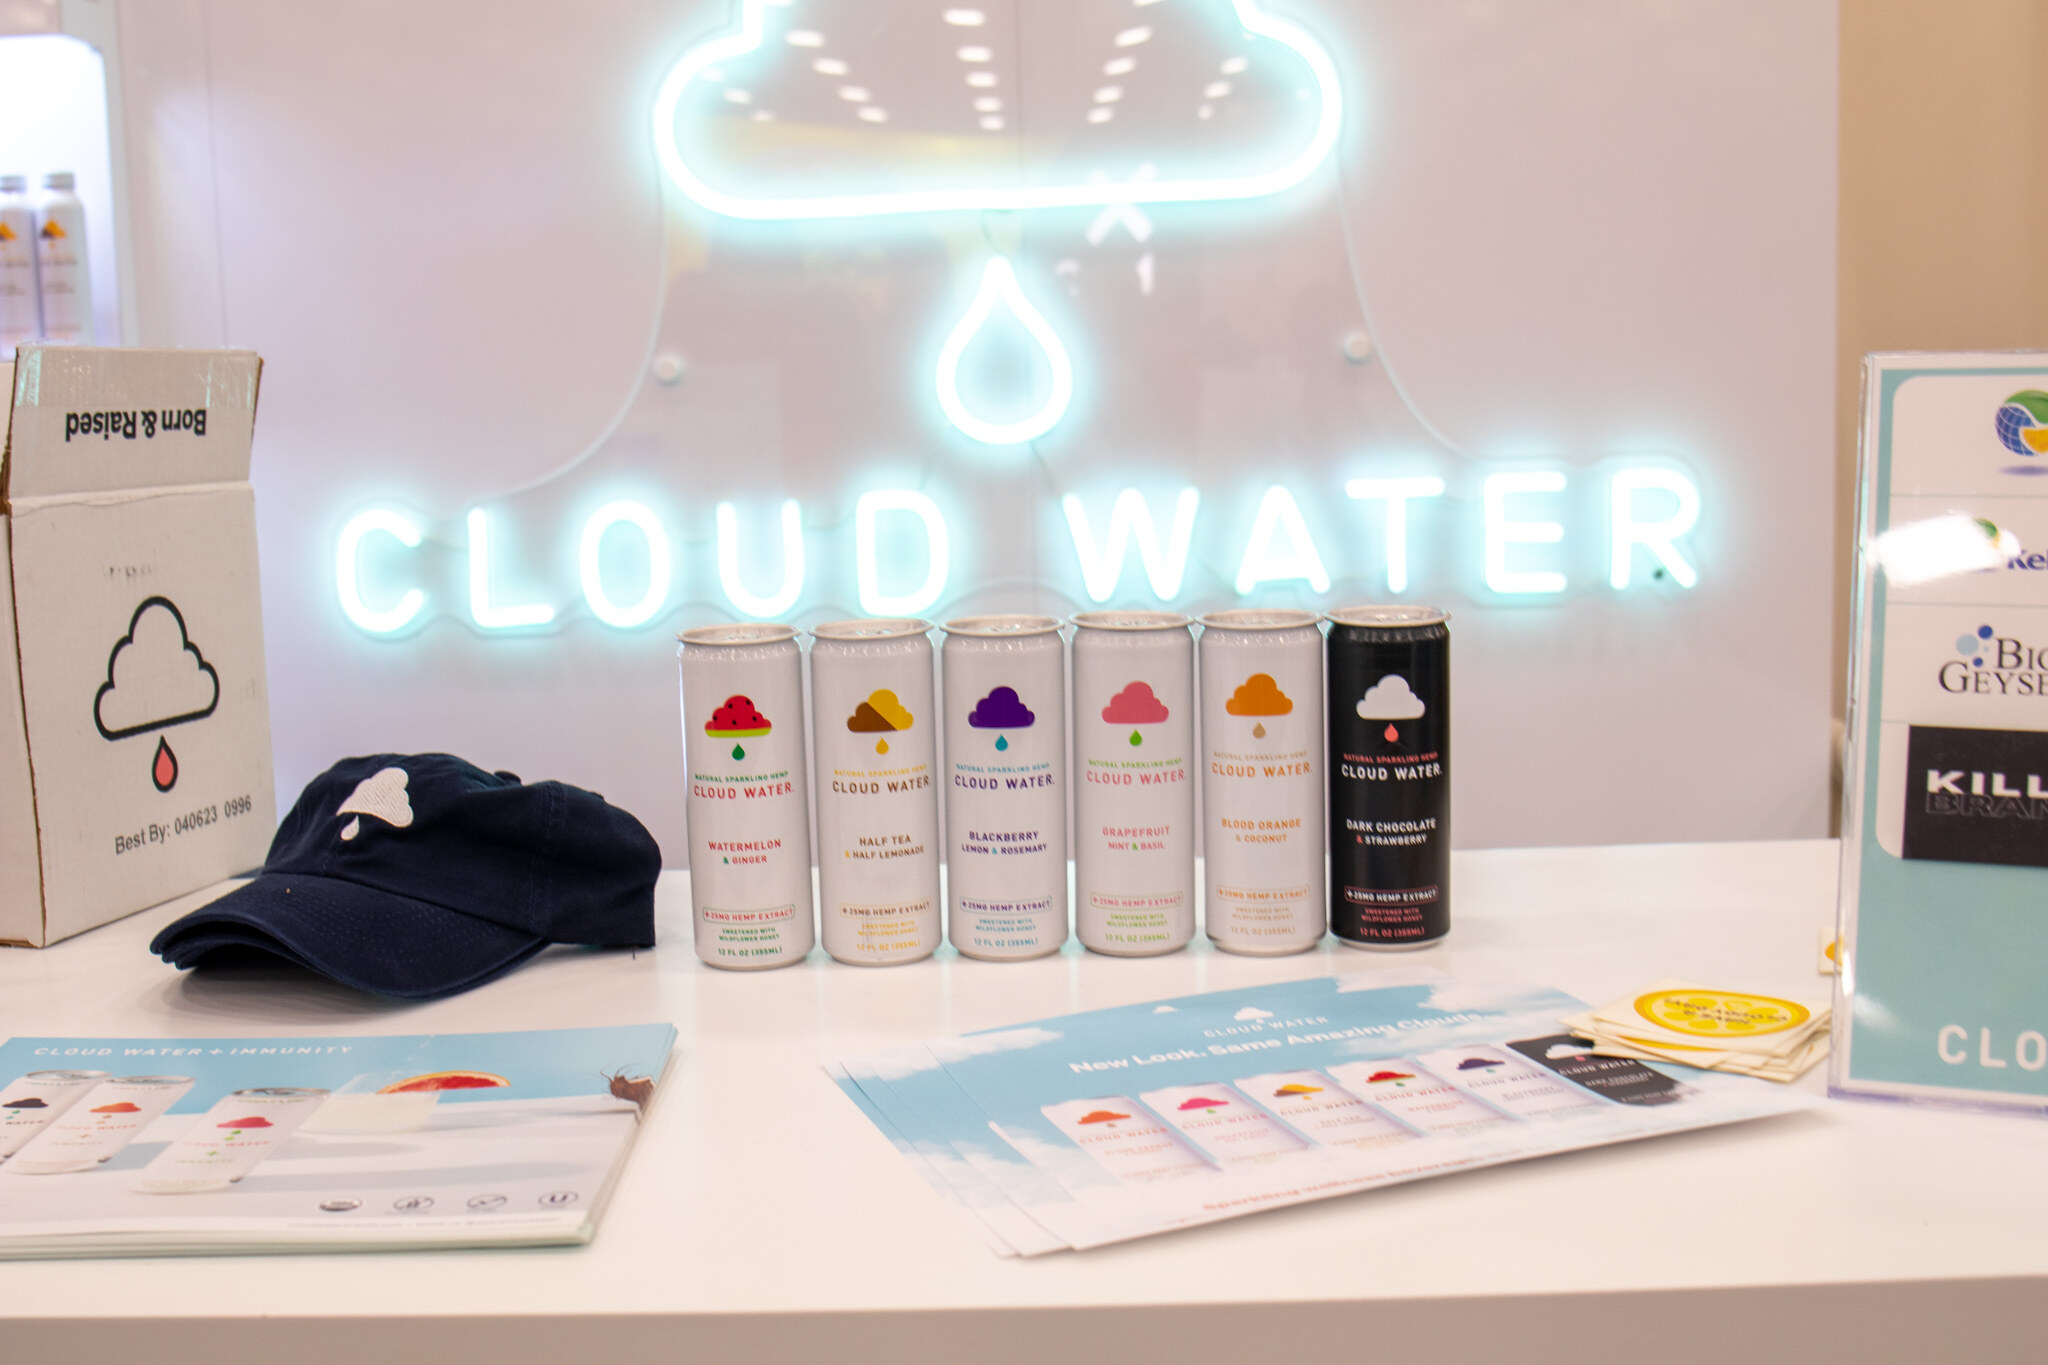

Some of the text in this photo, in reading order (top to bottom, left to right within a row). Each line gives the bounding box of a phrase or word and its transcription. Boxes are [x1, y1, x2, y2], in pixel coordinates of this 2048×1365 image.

[65, 409, 207, 443] Born & Raised
[335, 466, 1701, 634] CLOUD WATER
[1212, 761, 1256, 778] CLOUD
[1341, 763, 1388, 781] CLOUD
[955, 774, 998, 790] CLOUD
[1086, 770, 1132, 785] CLOUD
[694, 784, 736, 799] CLOUD
[832, 780, 879, 794] CLOUD
[115, 794, 252, 855] Best By: 040623 0996
[1221, 817, 1301, 830] BLOOD ORANGE
[1346, 817, 1437, 834] DARK CHOCOLATE
[969, 830, 1039, 842] BLACKBERRY
[1102, 825, 1170, 838] GRAPEFRUIT
[1244, 834, 1287, 843] COCONUT
[708, 838, 781, 852] WATERMELON
[859, 834, 911, 846] HALF TEA
[1108, 841, 1129, 850] MINT
[1140, 841, 1165, 850] BASIL
[1364, 833, 1427, 846] STRAWBERRY
[853, 850, 876, 859] HALF
[879, 845, 924, 859] LEMONADE
[961, 843, 989, 854] LEMON
[1001, 843, 1047, 855] ROSEMARY
[732, 855, 767, 864] GINGER
[1203, 1016, 1329, 1038] CLOUD WATER
[34, 1046, 113, 1056] CLOUD
[123, 1046, 201, 1056] WATER
[230, 1045, 354, 1056] IMMUNITY
[1068, 1058, 1129, 1073] New
[1132, 1048, 1207, 1066] Look.
[1207, 1038, 1283, 1055] Same
[1286, 1023, 1399, 1046] Amazing
[1938, 1024, 2047, 1071] CLO
